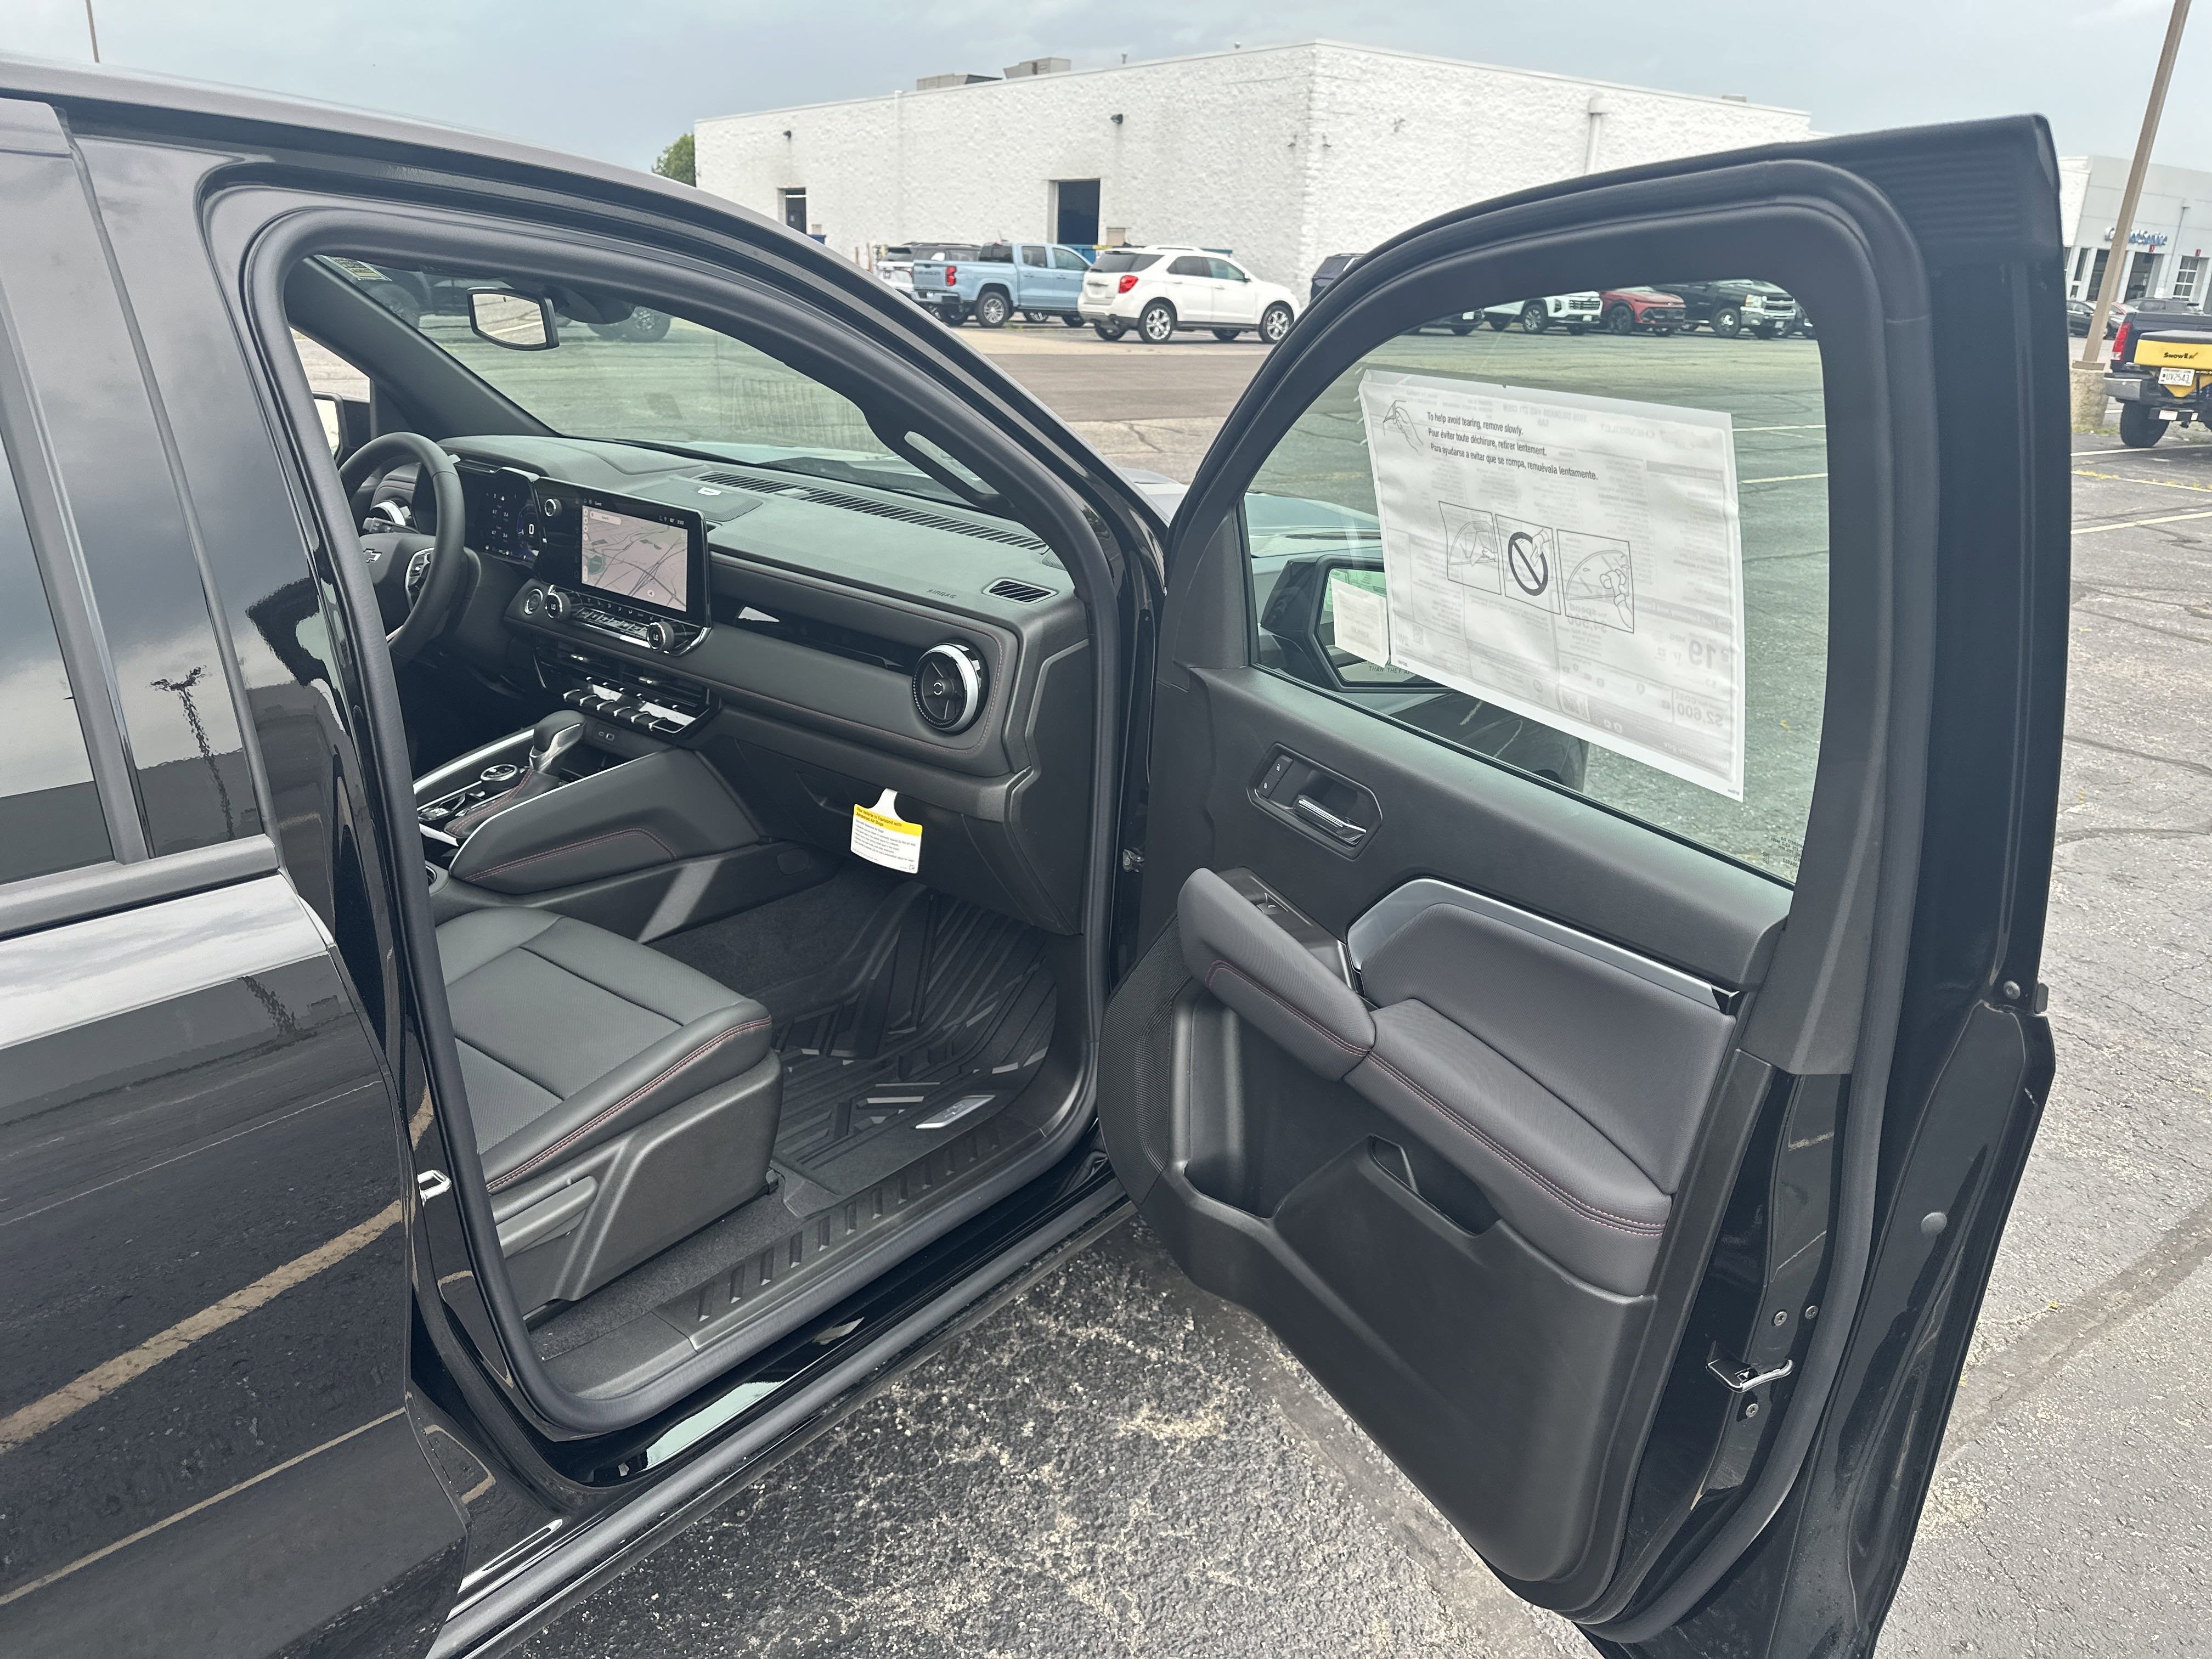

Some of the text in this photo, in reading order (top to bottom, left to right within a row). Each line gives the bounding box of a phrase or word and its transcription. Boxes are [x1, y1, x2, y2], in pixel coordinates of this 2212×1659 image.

[1427, 412, 1523, 436] To help avoid tearing, remove slowly.
[1428, 427, 1547, 456] Pour éviter toute déchirure, retirer lentement.
[1430, 443, 1441, 453] Para
[1442, 445, 1465, 458] ayudarse
[1470, 450, 1485, 461] evitar
[1486, 454, 1497, 465] que
[1498, 456, 1505, 465] se
[1506, 458, 1526, 470] rompa,
[1527, 461, 1558, 475] remuévala
[1559, 466, 1598, 481] lentamente.
[927, 589, 957, 599] AIRBAG
